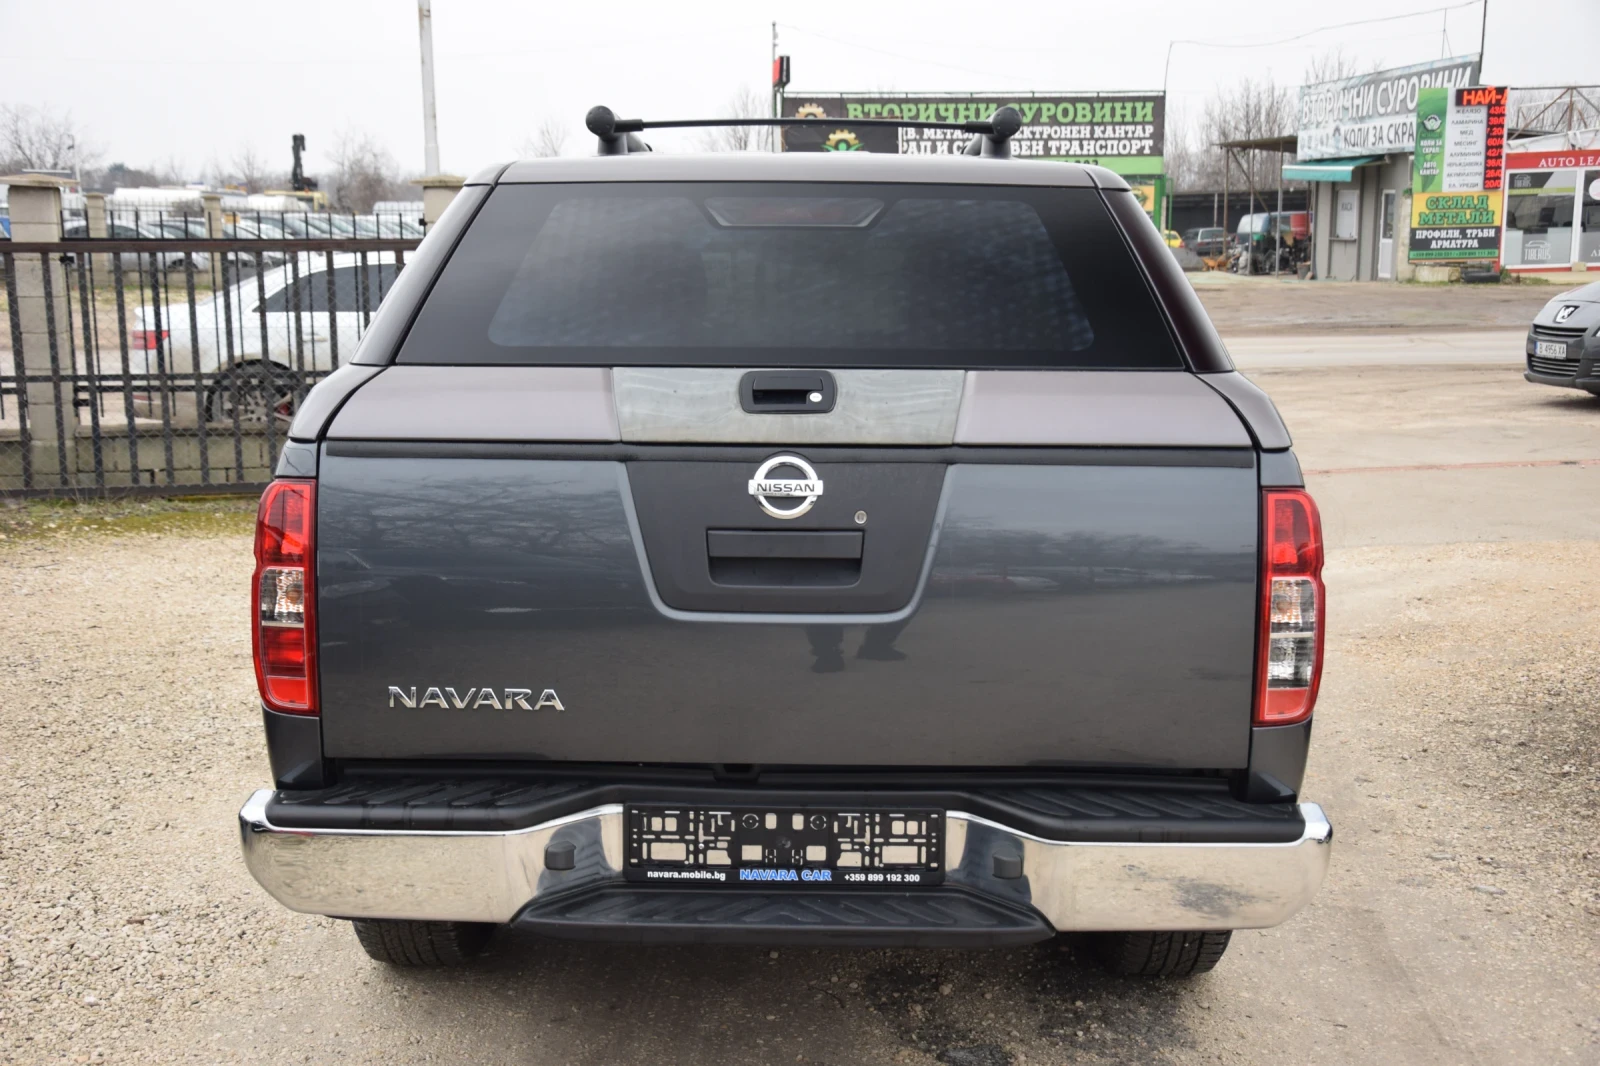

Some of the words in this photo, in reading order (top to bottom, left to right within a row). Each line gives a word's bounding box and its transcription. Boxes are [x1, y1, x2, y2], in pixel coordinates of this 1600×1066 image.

[1302, 83, 1375, 124] ВТОРИЧНИ
[846, 103, 997, 124] ВТОРИЧНИ
[1094, 124, 1154, 139] КАНТАР
[1343, 126, 1369, 148] КОЛИ
[1371, 125, 1384, 145] ЗА
[1048, 139, 1153, 156] ТРАНСПОРТ
[1538, 157, 1576, 168] AUTO
[1426, 195, 1489, 211] СКЛАД
[1418, 210, 1495, 226] МЕТАЛИ
[1415, 229, 1463, 239] ПРОФИЛИ,
[1465, 228, 1496, 238] ТРЪБИ
[1430, 239, 1479, 249] АРМАТУРА
[756, 483, 815, 492] NISSAN
[388, 686, 565, 711] NAVARA
[647, 870, 726, 881] navara.mobile.bg
[739, 868, 799, 881] NAVARA
[801, 869, 832, 881] CAR
[844, 873, 866, 882] +359
[867, 873, 884, 882] 899
[886, 874, 902, 882] 192
[903, 874, 920, 882] 300
